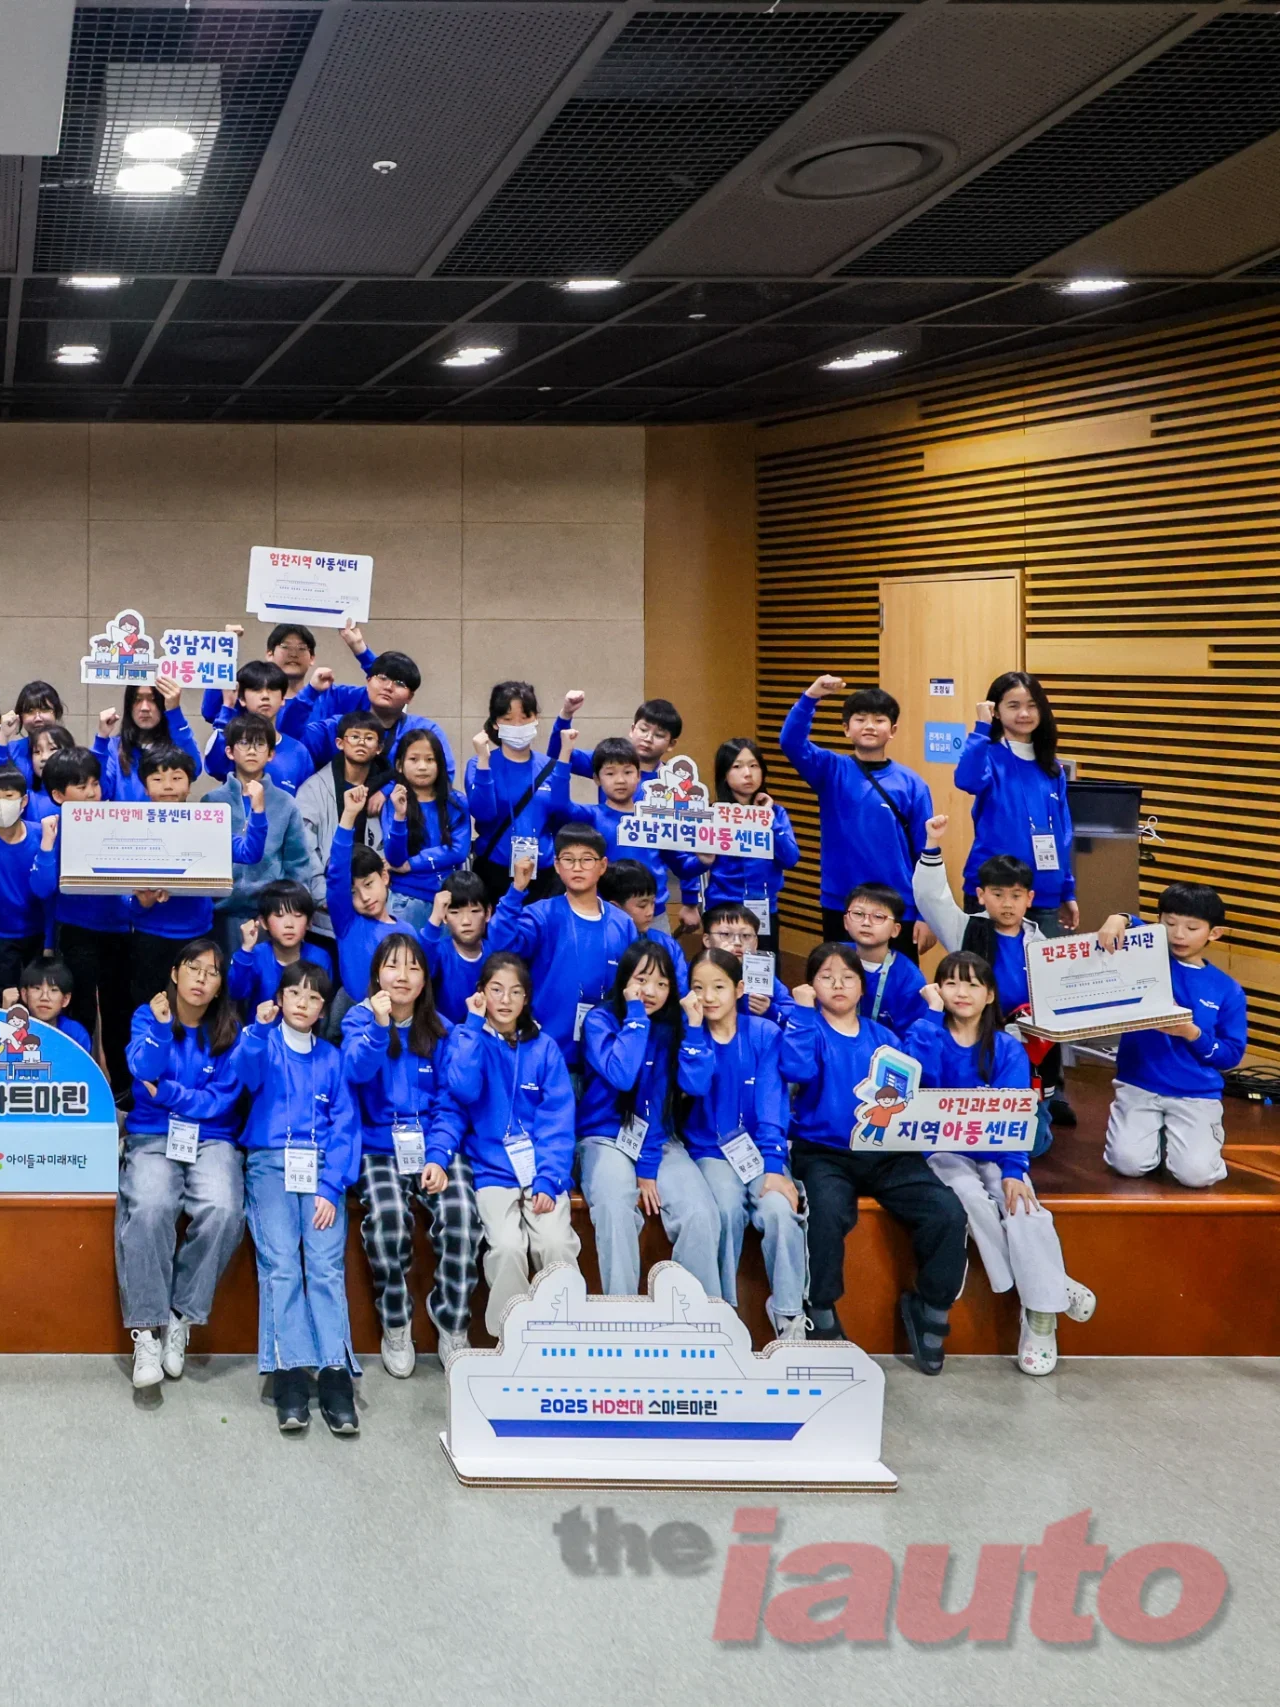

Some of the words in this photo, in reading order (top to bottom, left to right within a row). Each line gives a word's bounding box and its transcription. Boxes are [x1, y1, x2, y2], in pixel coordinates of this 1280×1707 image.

[269, 553, 312, 570] 힘찬지역
[315, 557, 358, 572] 아동센터
[165, 634, 234, 657] 성남지역
[161, 660, 234, 683] 아동센터
[71, 808, 105, 822] 성남시
[108, 808, 143, 822] 다함께
[146, 808, 191, 823] 돌봄센터
[194, 809, 224, 823] 8호점
[718, 806, 771, 827] 작은사랑
[623, 819, 770, 852] 성남지역아동센터
[1041, 941, 1091, 963] 판교종합
[938, 1097, 1032, 1116] 야긴과보아즈
[897, 1120, 1028, 1146] 지역아동센터
[6, 1154, 88, 1169] 아이들과미래재단
[540, 1398, 588, 1414] 2025
[592, 1399, 643, 1415] HD현대
[648, 1399, 718, 1416] 스마트마린
